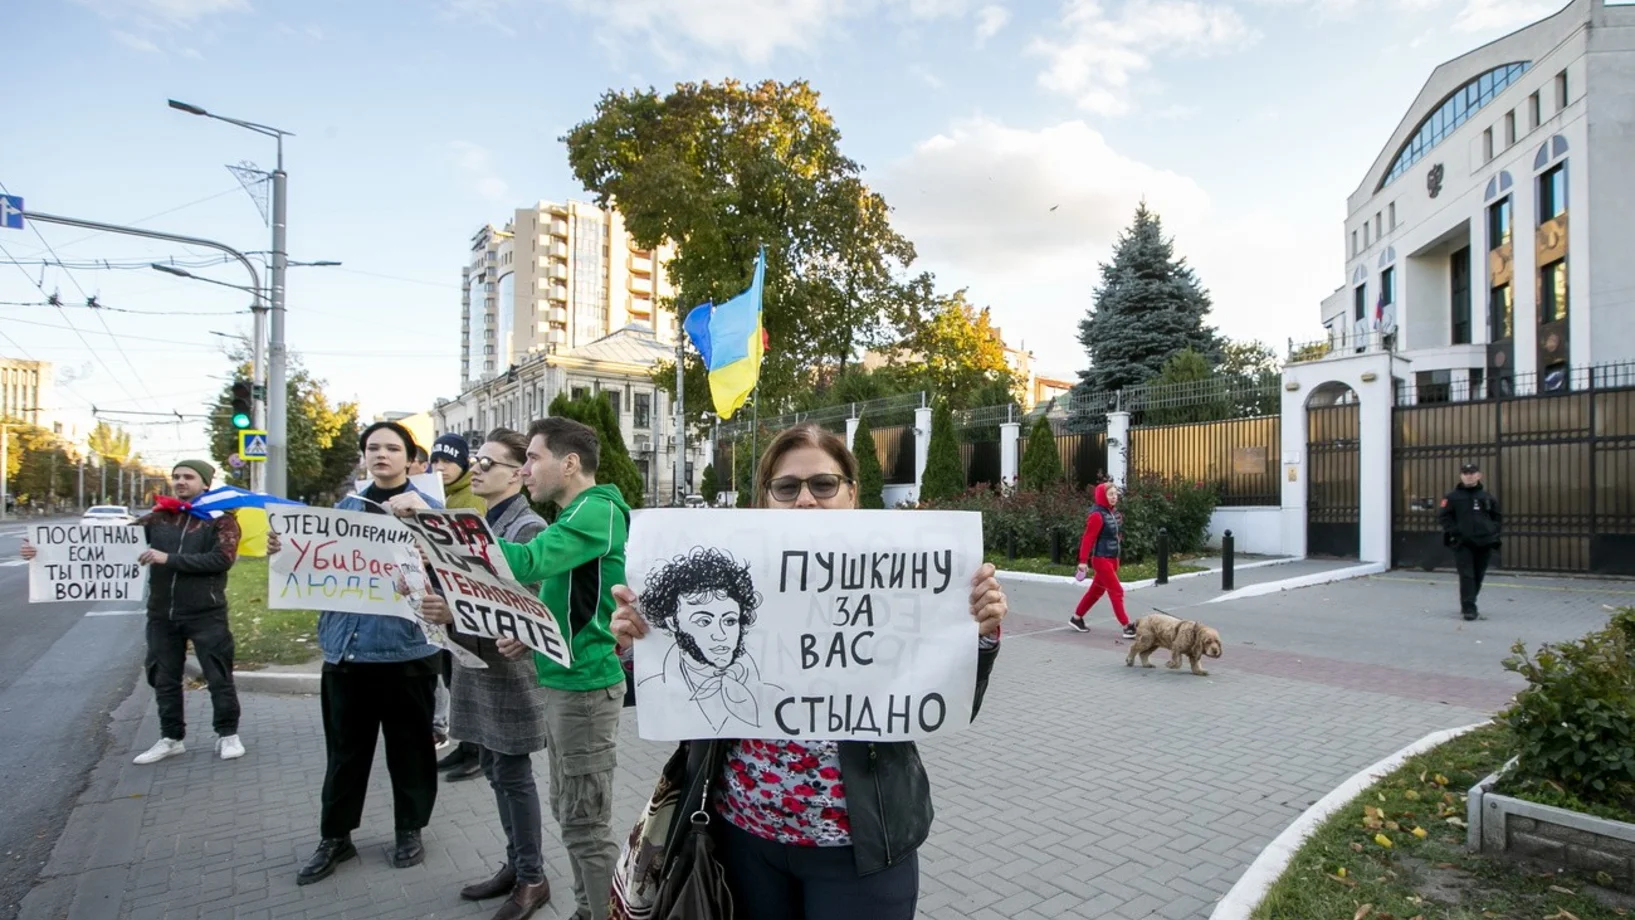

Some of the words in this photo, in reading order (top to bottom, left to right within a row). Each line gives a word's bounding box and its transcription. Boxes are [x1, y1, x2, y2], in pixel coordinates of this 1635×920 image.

[37, 526, 139, 544] ПОСИГНАЛЬ
[69, 546, 105, 562] ЕСЛИ
[45, 565, 72, 580] ТЫ
[81, 564, 140, 580] ПРОТИВ
[290, 538, 400, 577] Убивае
[779, 550, 952, 594] ПУШКИНУ
[56, 582, 128, 600] ВОЙНЫ
[436, 568, 553, 622] TERRORIST
[833, 593, 874, 627] ЗА
[455, 600, 563, 660] STATE
[800, 631, 875, 670] ВАС
[774, 692, 947, 736] СТЫДНО
